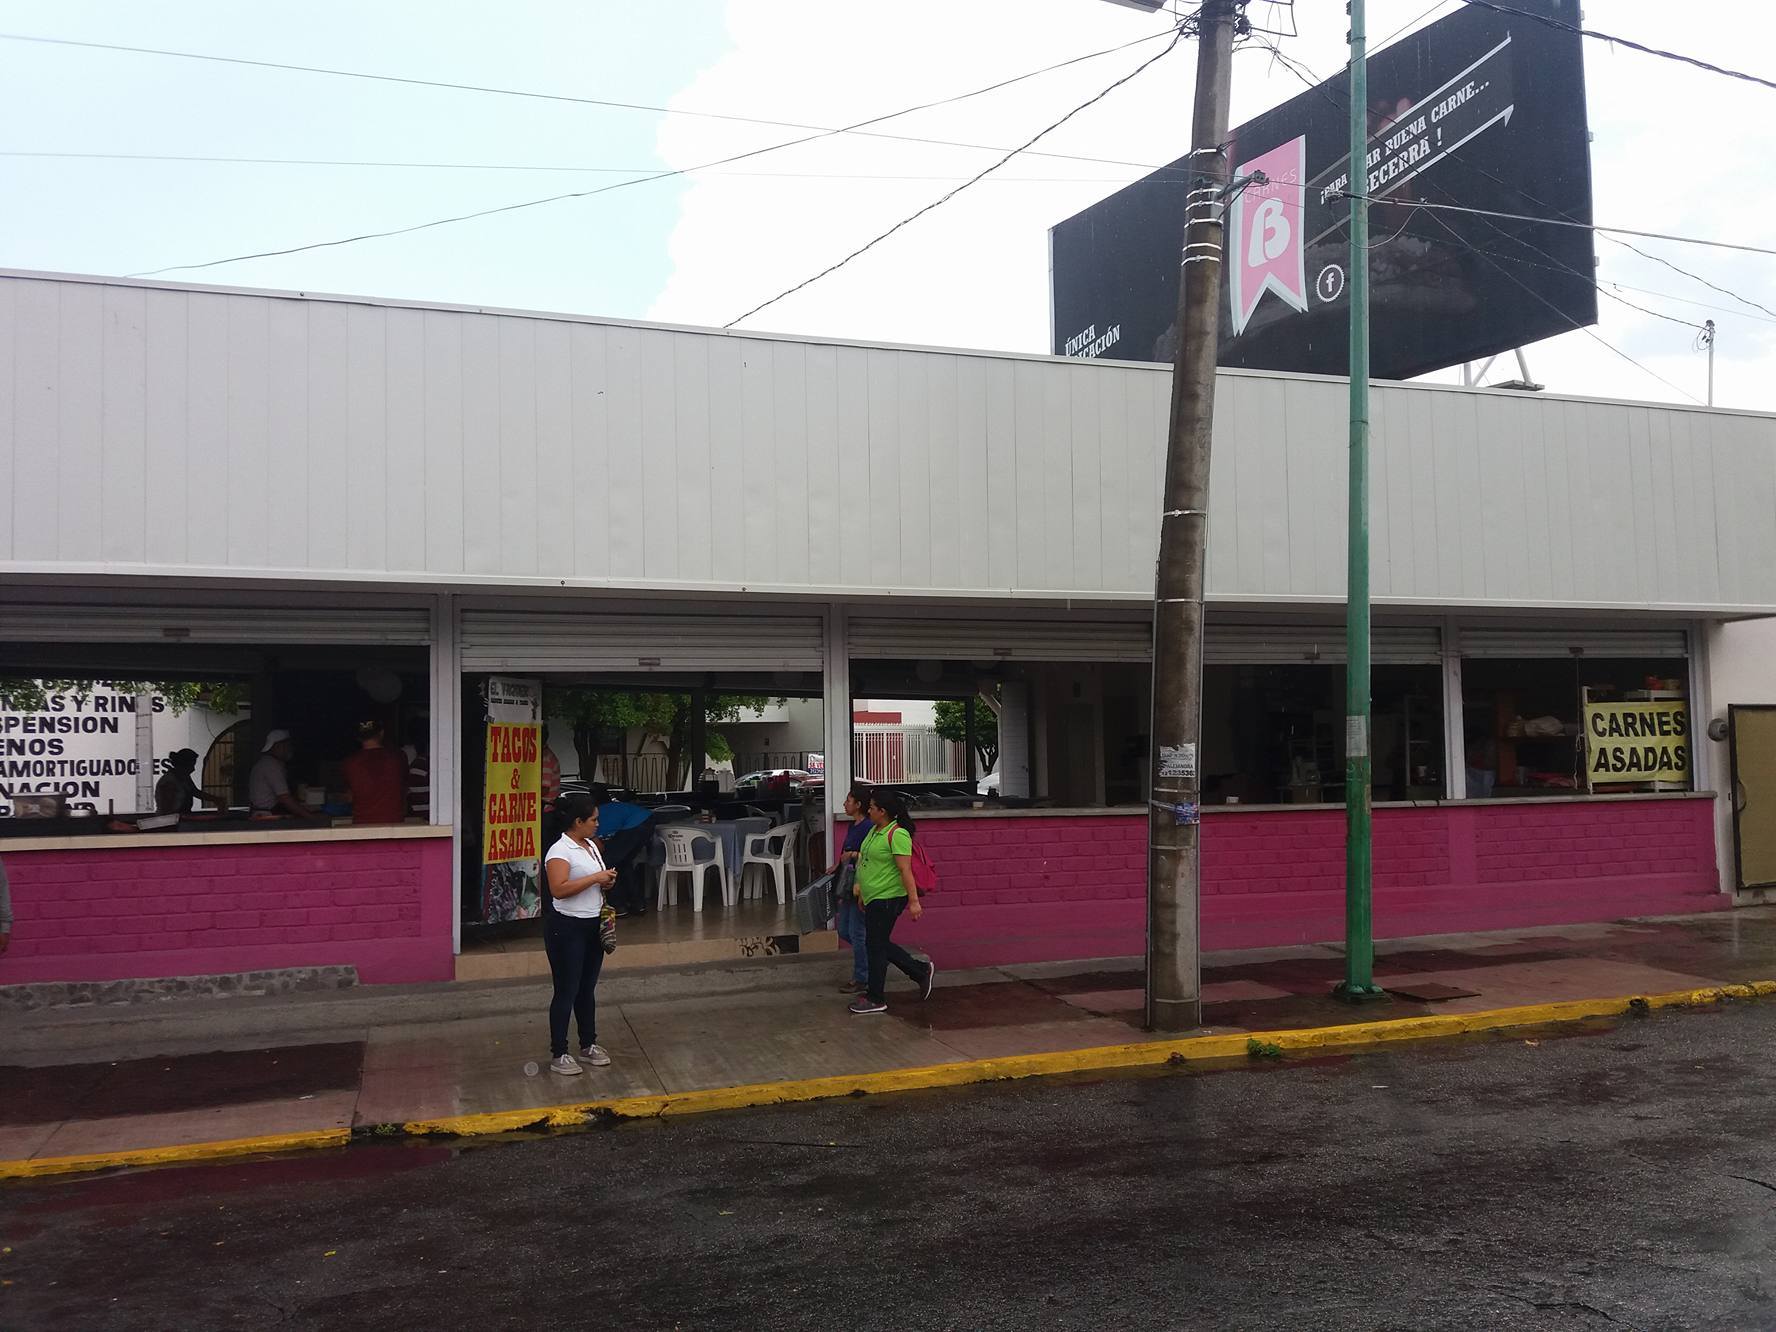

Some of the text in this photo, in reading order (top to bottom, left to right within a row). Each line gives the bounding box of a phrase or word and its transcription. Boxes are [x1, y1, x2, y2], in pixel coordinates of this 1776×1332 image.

[1384, 114, 1427, 156] BUENA
[1366, 136, 1431, 194] ECERRÁ
[1065, 324, 1096, 357] ÚNICA
[71, 695, 88, 712] Y
[94, 695, 165, 713] RINS
[0, 716, 118, 734] PENSION
[1592, 711, 1686, 738] CARNES
[490, 726, 537, 763] TACOS
[1593, 745, 1687, 772] ASADAS
[0, 759, 175, 777] AMORTIGUADOES
[511, 768, 520, 789] &
[489, 792, 537, 825] CARNE
[487, 827, 535, 861] ASADA
